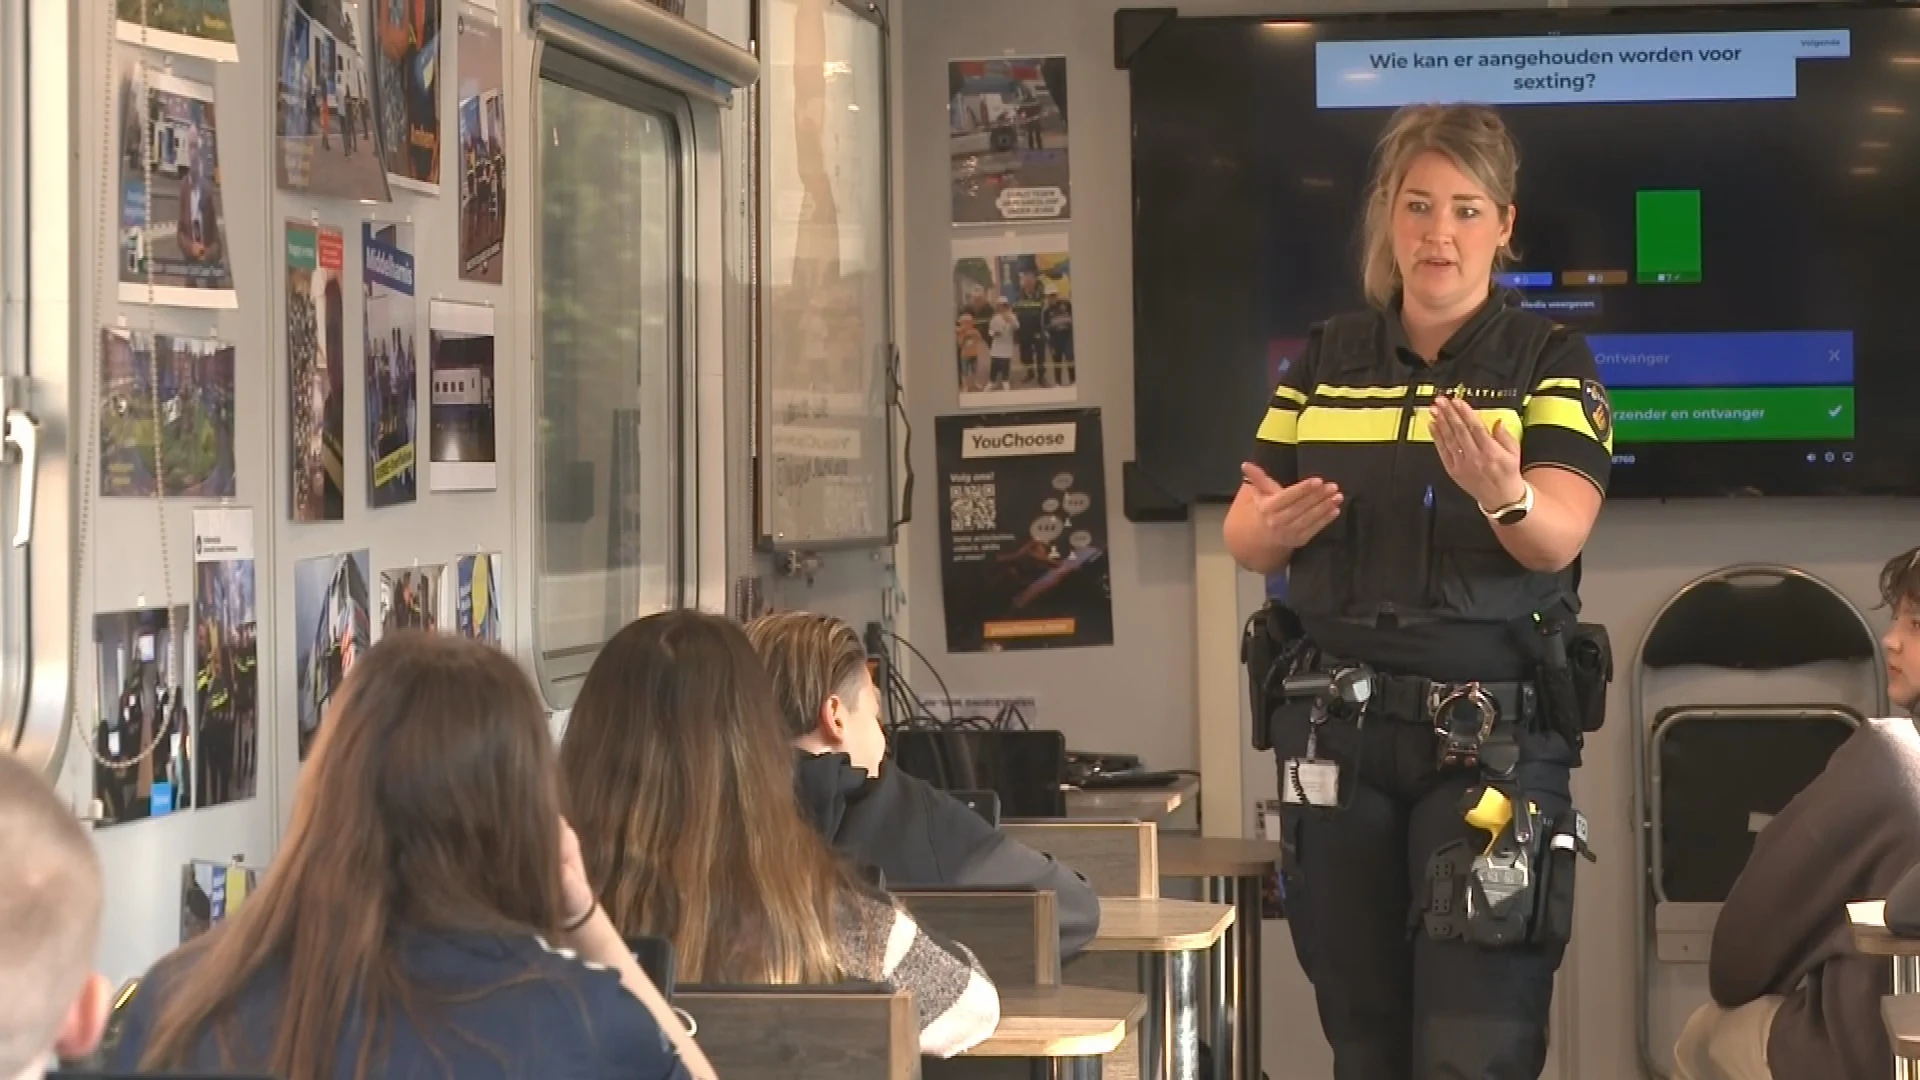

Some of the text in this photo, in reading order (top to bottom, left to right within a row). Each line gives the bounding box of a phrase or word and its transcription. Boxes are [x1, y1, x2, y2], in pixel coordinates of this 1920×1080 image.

[1370, 45, 1742, 70] Wie kan er aangehouden worden voor
[1513, 71, 1597, 92] sexting?
[1594, 352, 1671, 367] Ontvanger
[1671, 409, 1689, 420] en
[1693, 407, 1765, 422] ontvanger
[972, 432, 1065, 450] YouChoose
